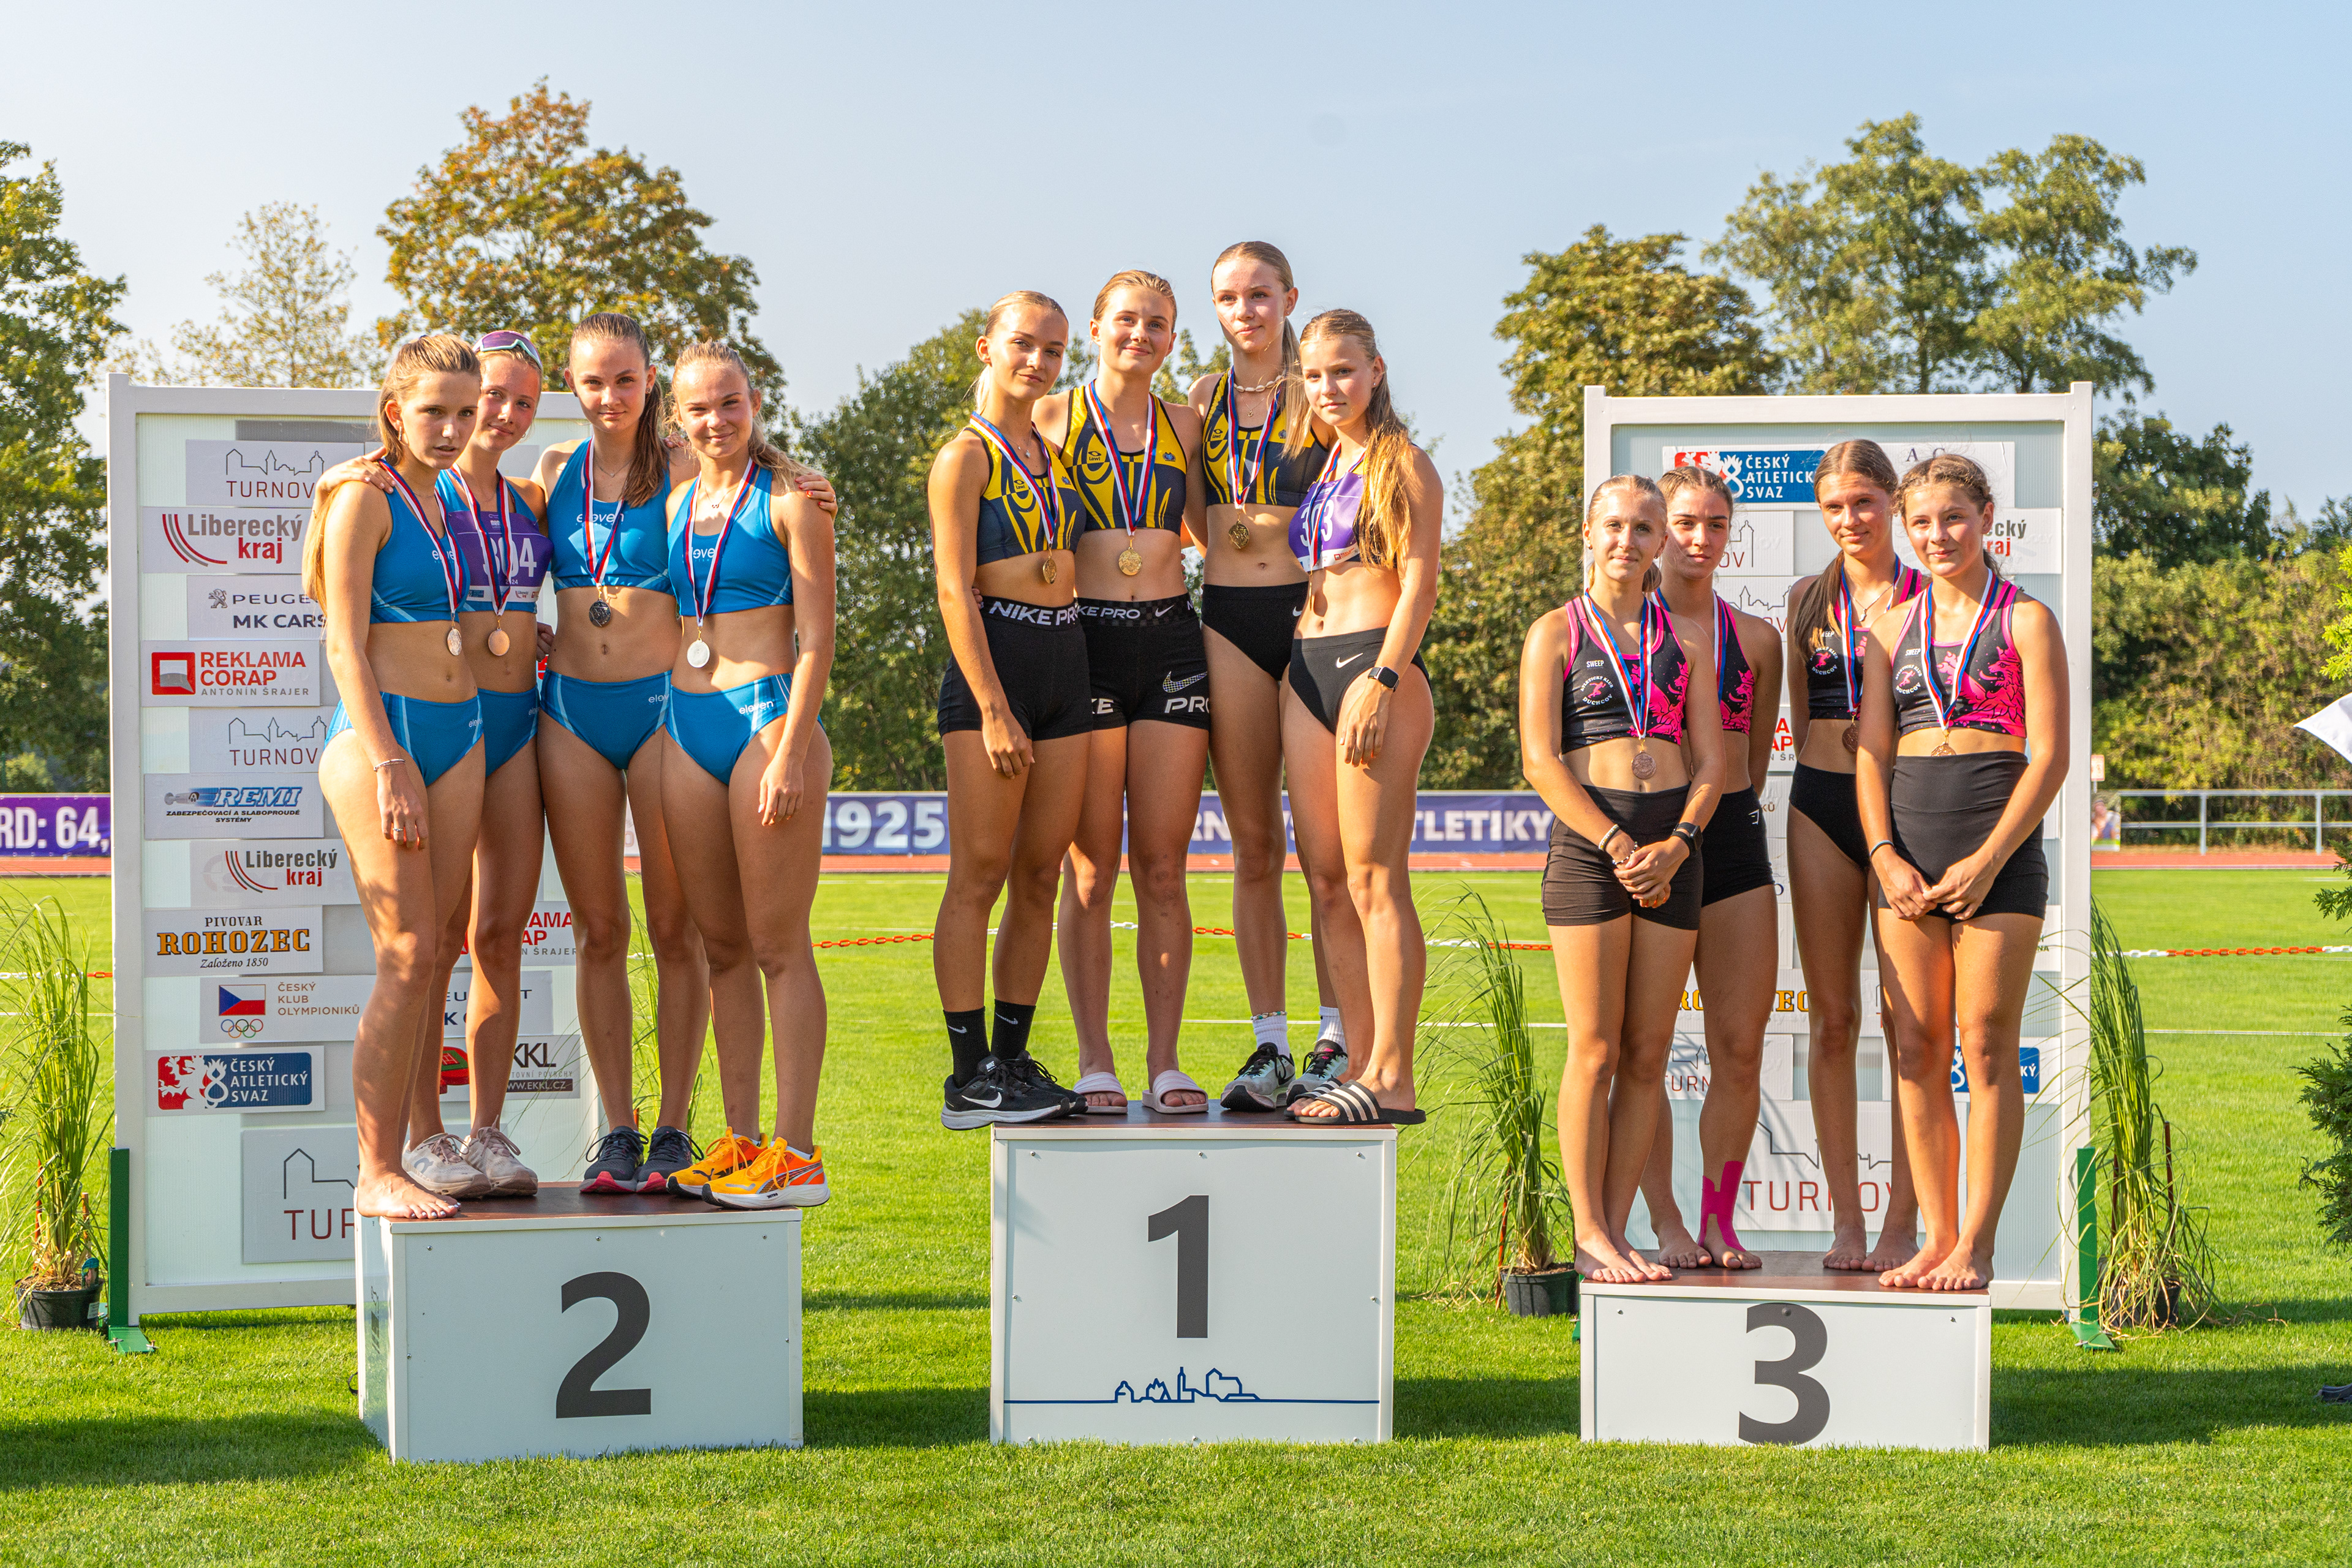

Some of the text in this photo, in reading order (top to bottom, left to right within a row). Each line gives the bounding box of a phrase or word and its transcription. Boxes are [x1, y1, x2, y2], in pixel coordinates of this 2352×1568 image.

[1746, 454, 1790, 469] ČESKÝ
[1746, 471, 1814, 484] ATLETICK
[226, 481, 315, 499] TURNOV
[1747, 486, 1783, 499] SVAZ
[188, 513, 303, 541] Liberecký
[238, 537, 282, 564] kraj
[1983, 538, 2011, 556] raj
[233, 594, 318, 605] PEUGE
[233, 614, 326, 628] MK CARS
[989, 600, 1054, 625] NIKE
[1100, 608, 1140, 619] PRO
[200, 652, 306, 668] REKLAMA
[1586, 660, 1604, 668] SWEEP
[200, 669, 277, 686] CORAP
[202, 686, 309, 696] ANTONÍN ŠRAJER
[1582, 693, 1613, 706] DUCHCOV
[739, 700, 774, 715] eleven
[1164, 696, 1209, 714] PR
[229, 747, 318, 766] TURNOV
[214, 787, 303, 807] REMI
[56, 806, 110, 853] 64,
[1411, 810, 1555, 841] TLETIKY
[246, 849, 337, 869] Liberecký
[287, 868, 322, 887] kraj
[205, 916, 263, 927] PIVOVAR
[157, 929, 310, 956] ROHOZEC
[200, 957, 268, 968] Založeno 1850
[278, 981, 316, 992] ČESKÝ
[277, 1003, 360, 1016] OLYMPIONIKŮ
[230, 1057, 275, 1072] ČESKÝ
[230, 1071, 308, 1088] ATLETICKÝ
[508, 1081, 566, 1090] WW.EKKL.CZ
[232, 1090, 268, 1102] SVAZ
[1743, 1180, 1891, 1212] TURO
[284, 1208, 355, 1240] TUR
[1148, 1194, 1209, 1338] 1
[556, 1271, 651, 1419] 2
[1738, 1302, 1831, 1446] 3
